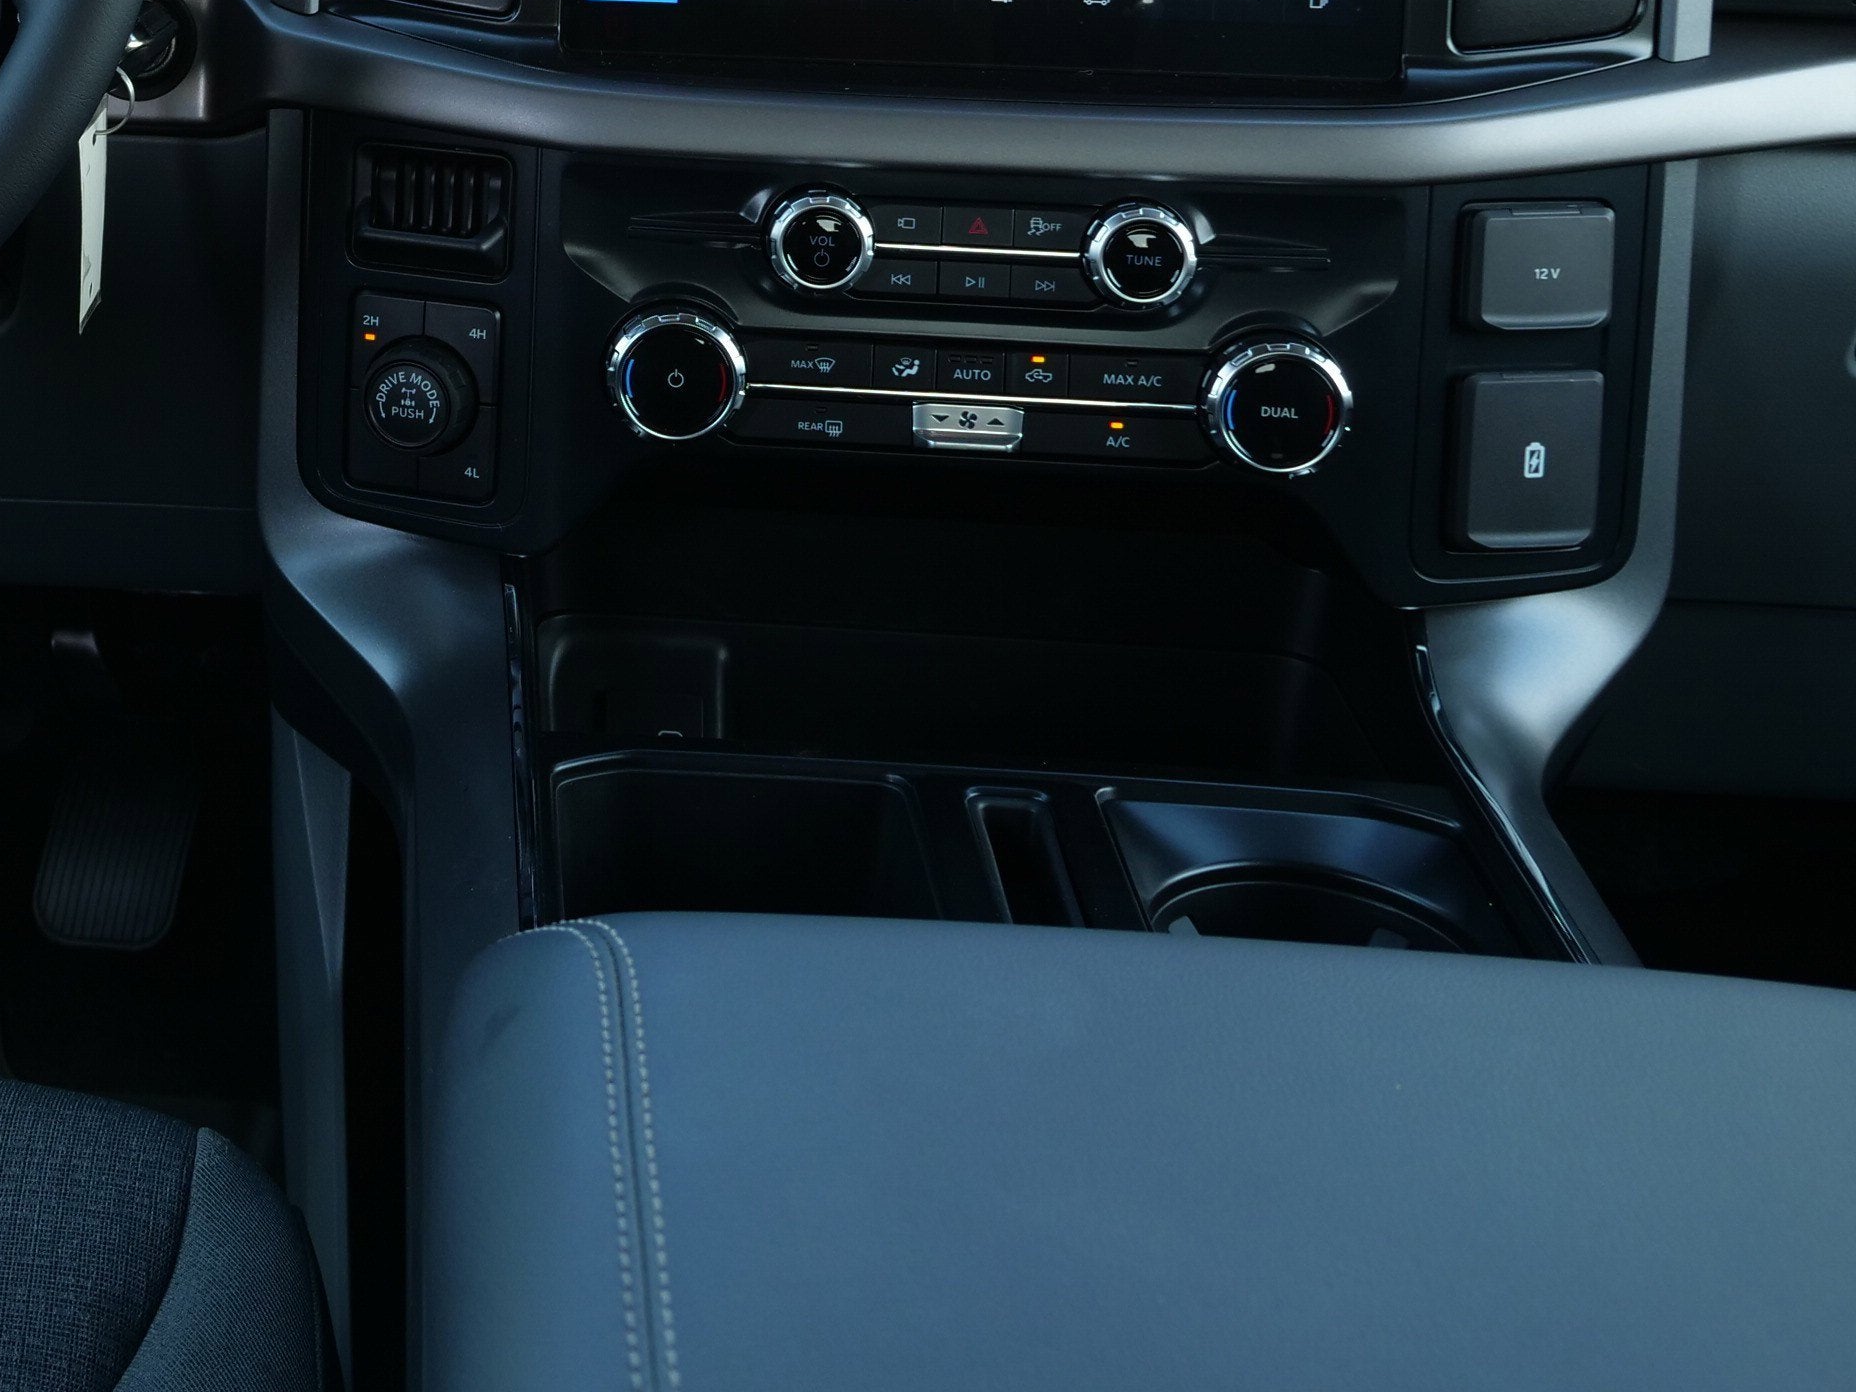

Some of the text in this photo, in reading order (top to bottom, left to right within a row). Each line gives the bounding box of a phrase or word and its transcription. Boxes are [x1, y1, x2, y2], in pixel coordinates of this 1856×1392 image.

[1043, 222, 1062, 232] OFF
[809, 235, 835, 247] VOL
[1126, 254, 1162, 267] TUNE
[363, 314, 380, 327] 2H
[468, 328, 486, 340] 4H
[791, 359, 814, 369] MAX
[953, 369, 991, 382] AUTO
[1103, 373, 1162, 388] MAX A/C
[375, 371, 440, 408] DRIVE MODE
[391, 406, 424, 419] PUSH
[1261, 406, 1298, 419] DUAL
[798, 422, 823, 432] REAR
[1106, 435, 1131, 448] A/C
[464, 467, 480, 479] 4L
